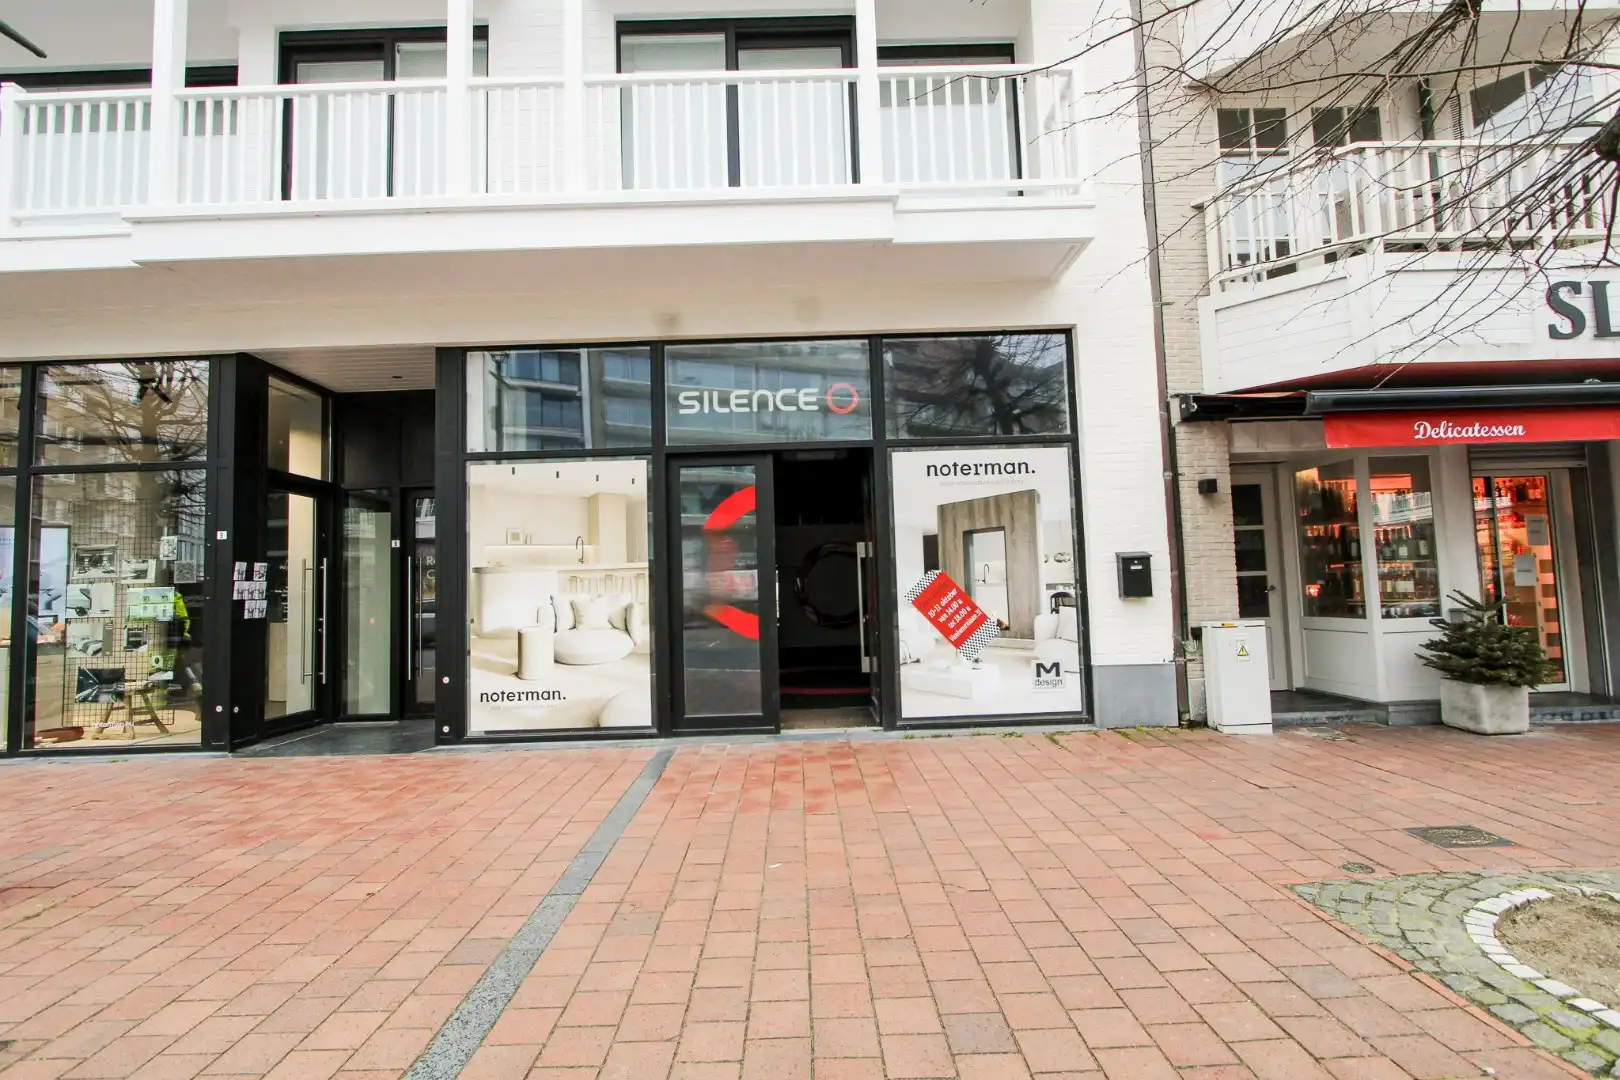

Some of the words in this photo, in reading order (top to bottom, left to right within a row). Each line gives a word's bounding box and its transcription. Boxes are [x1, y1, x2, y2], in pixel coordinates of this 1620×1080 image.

[678, 388, 819, 414] SILENCE
[1414, 420, 1526, 439] Delicatessen
[926, 461, 1036, 477] noterman.
[1036, 662, 1060, 678] M
[1034, 678, 1063, 688] design
[480, 690, 566, 703] noterman.
